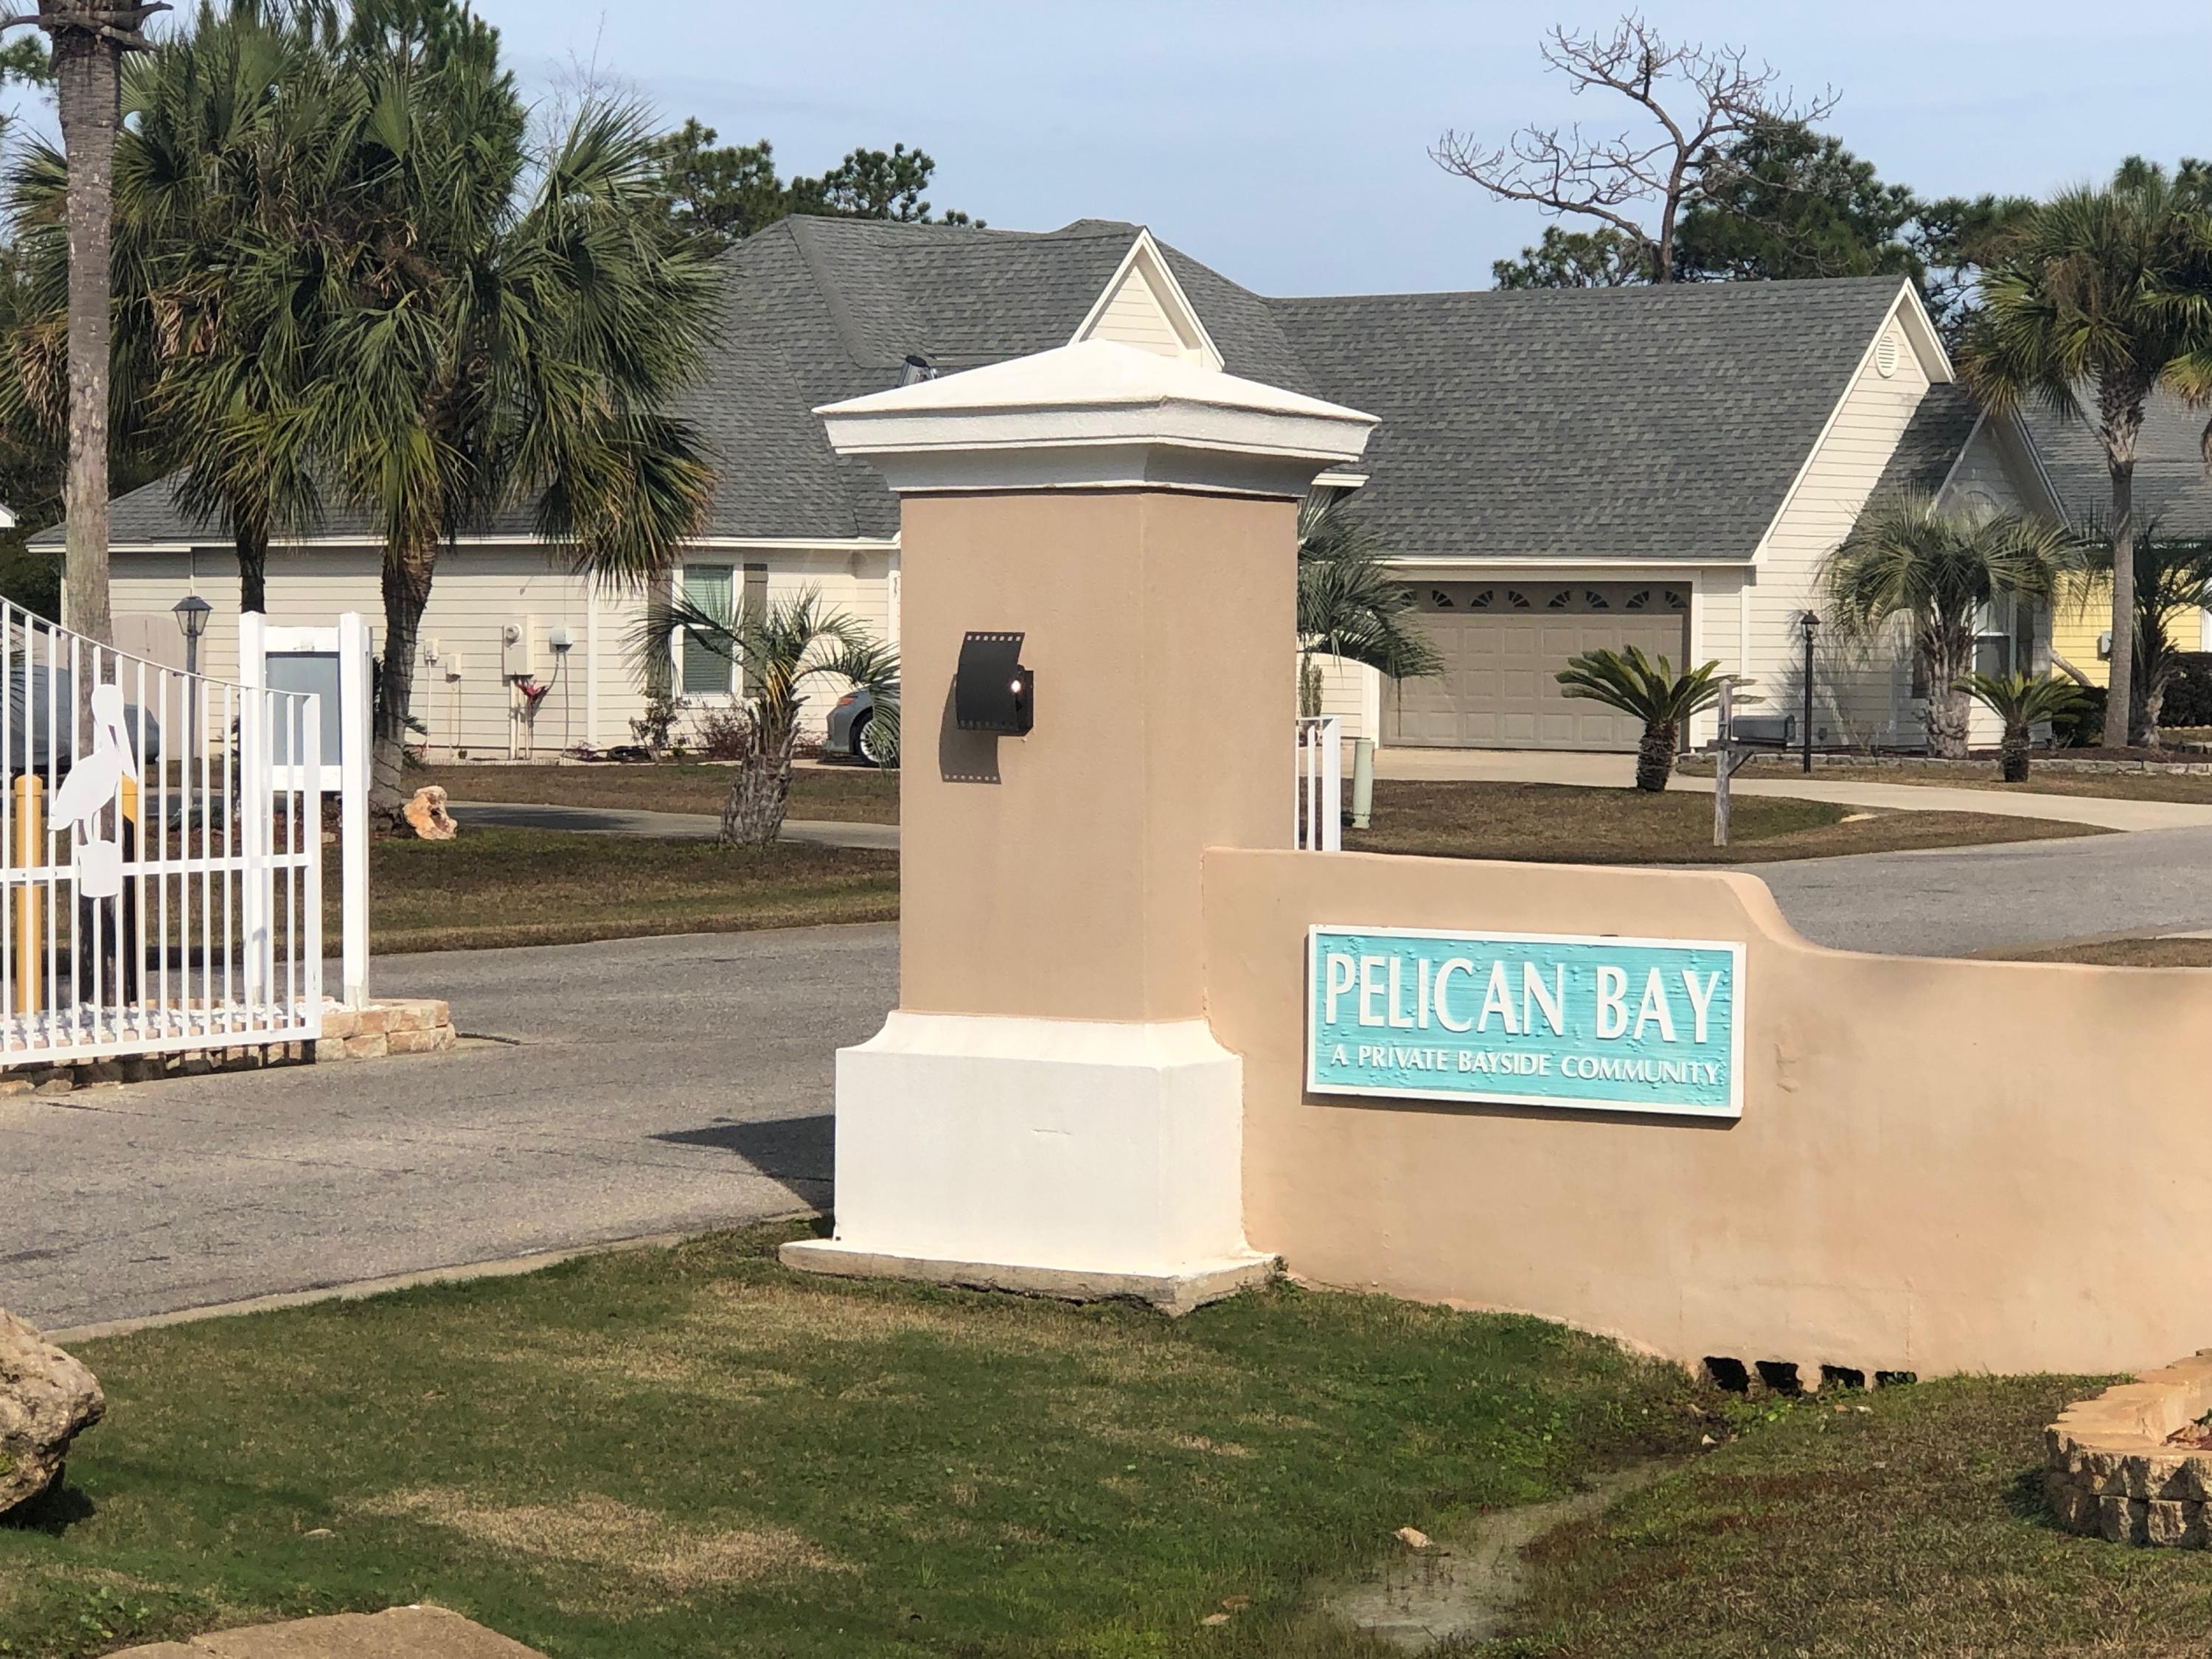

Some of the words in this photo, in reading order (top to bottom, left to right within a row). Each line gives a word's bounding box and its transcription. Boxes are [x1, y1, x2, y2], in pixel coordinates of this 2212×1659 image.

[1324, 953, 1565, 1036] PELICAN
[1595, 964, 1722, 1043] BAY
[1331, 1045, 1349, 1066] A
[1358, 1045, 1449, 1071] PRIVATE
[1458, 1050, 1552, 1077] BAYSIDE
[1561, 1055, 1720, 1086] COMMUNITY
